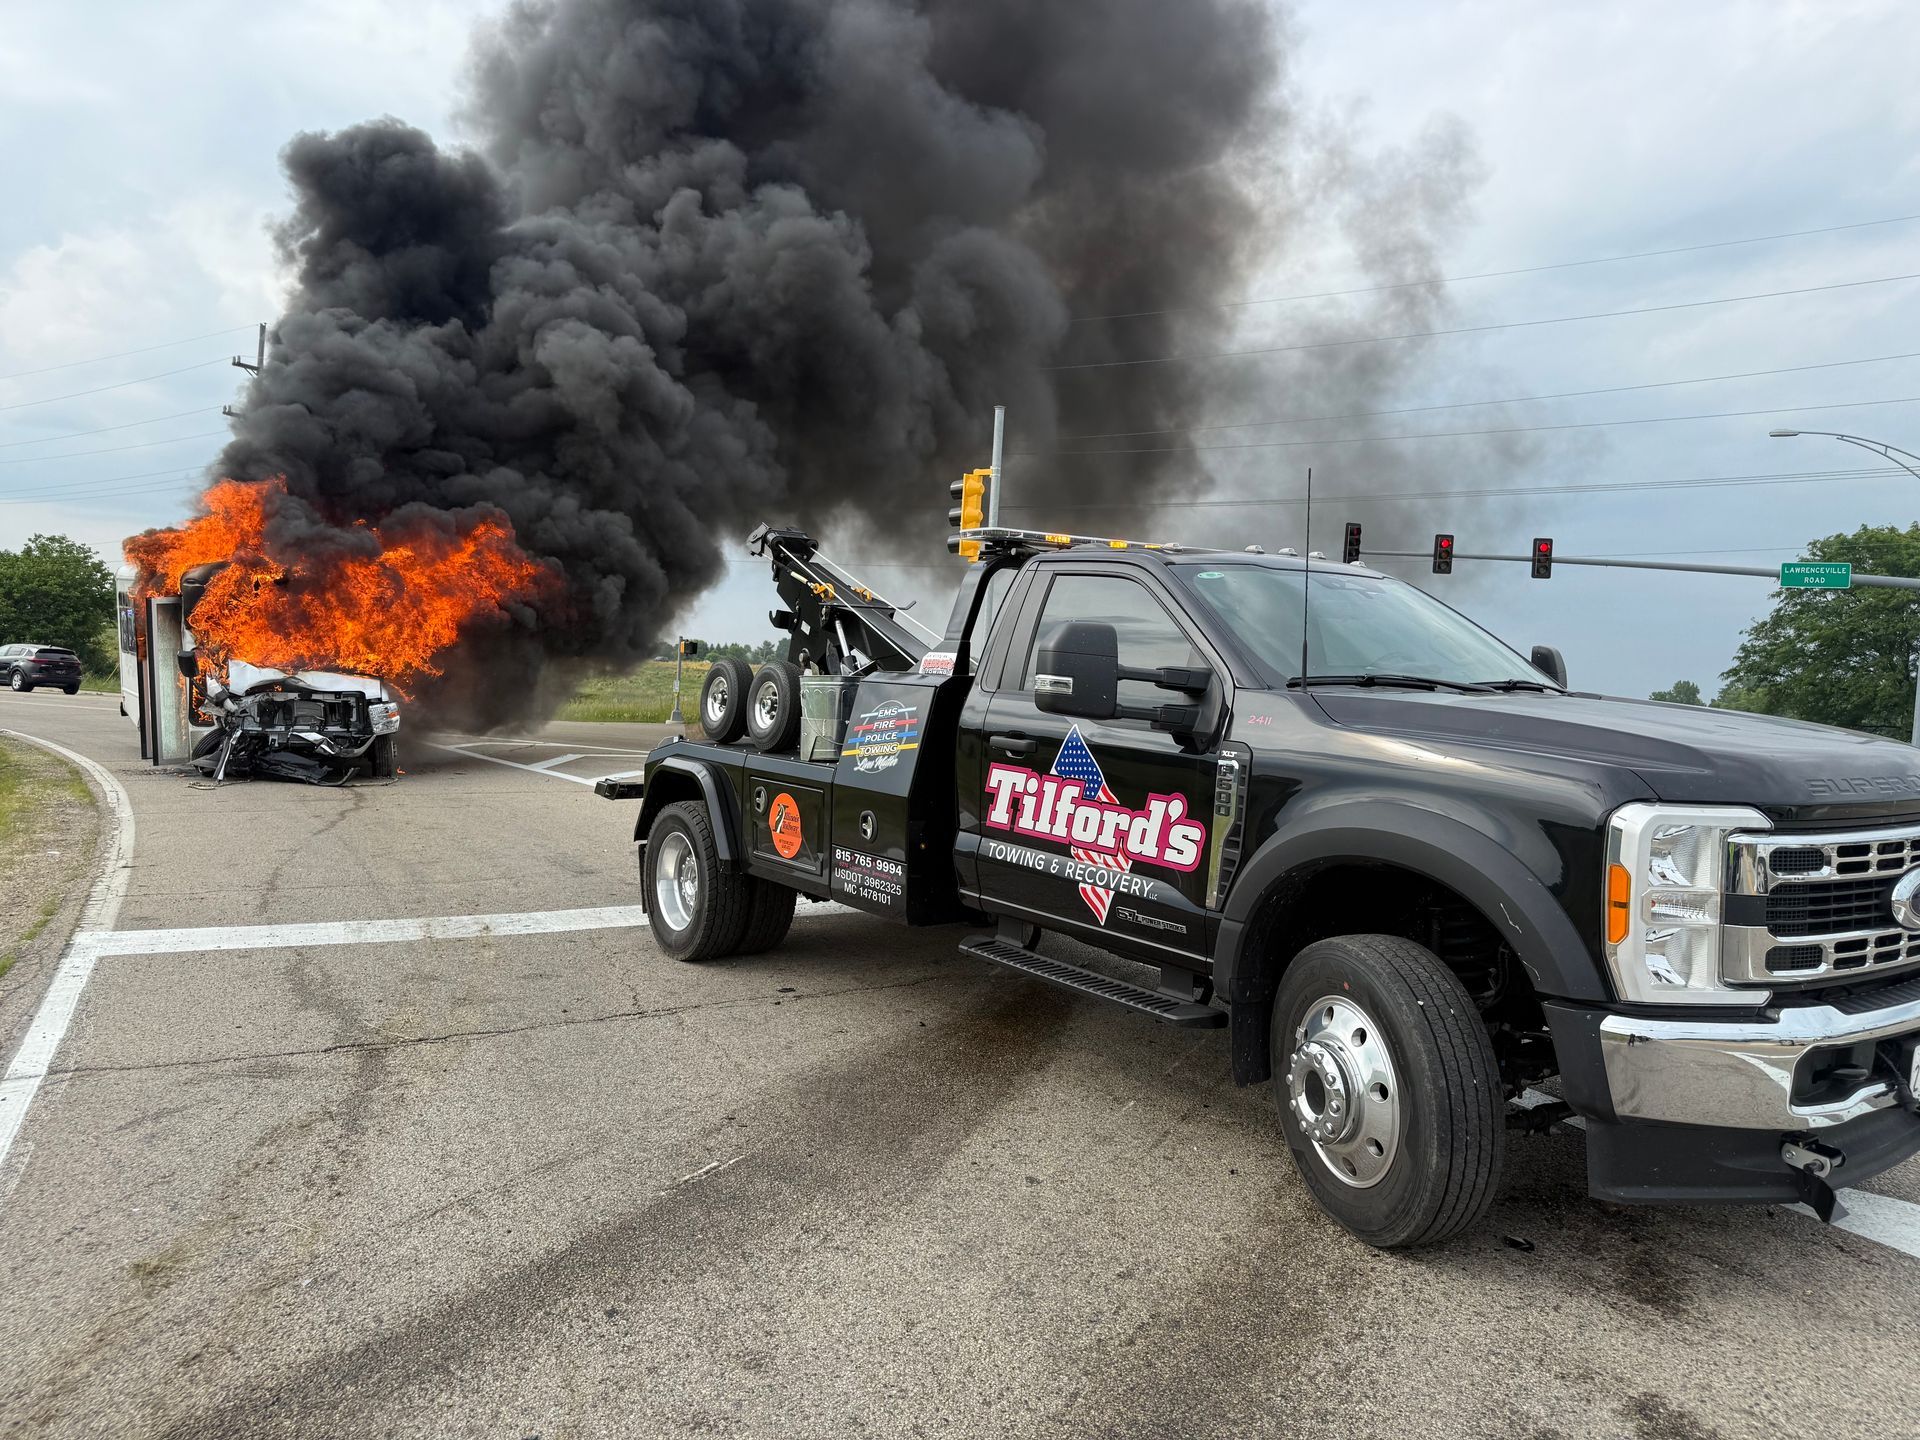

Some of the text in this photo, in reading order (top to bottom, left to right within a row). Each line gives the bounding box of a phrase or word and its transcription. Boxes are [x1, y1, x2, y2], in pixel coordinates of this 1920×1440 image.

[1784, 566, 1847, 574] LAWRENCEVILLE
[878, 707, 898, 717] EMS
[873, 719, 896, 730] FIRE
[865, 731, 898, 743] POLICE
[859, 743, 898, 756] TOWING
[1222, 750, 1238, 758] XLT
[987, 764, 1204, 869] Tilford's
[988, 842, 1046, 871] TOWING
[1050, 859, 1060, 874] &
[1065, 862, 1155, 898] RECOVERY
[835, 867, 863, 884] USDOT
[864, 875, 902, 896] 3962325
[844, 881, 891, 906] MC 1478101
